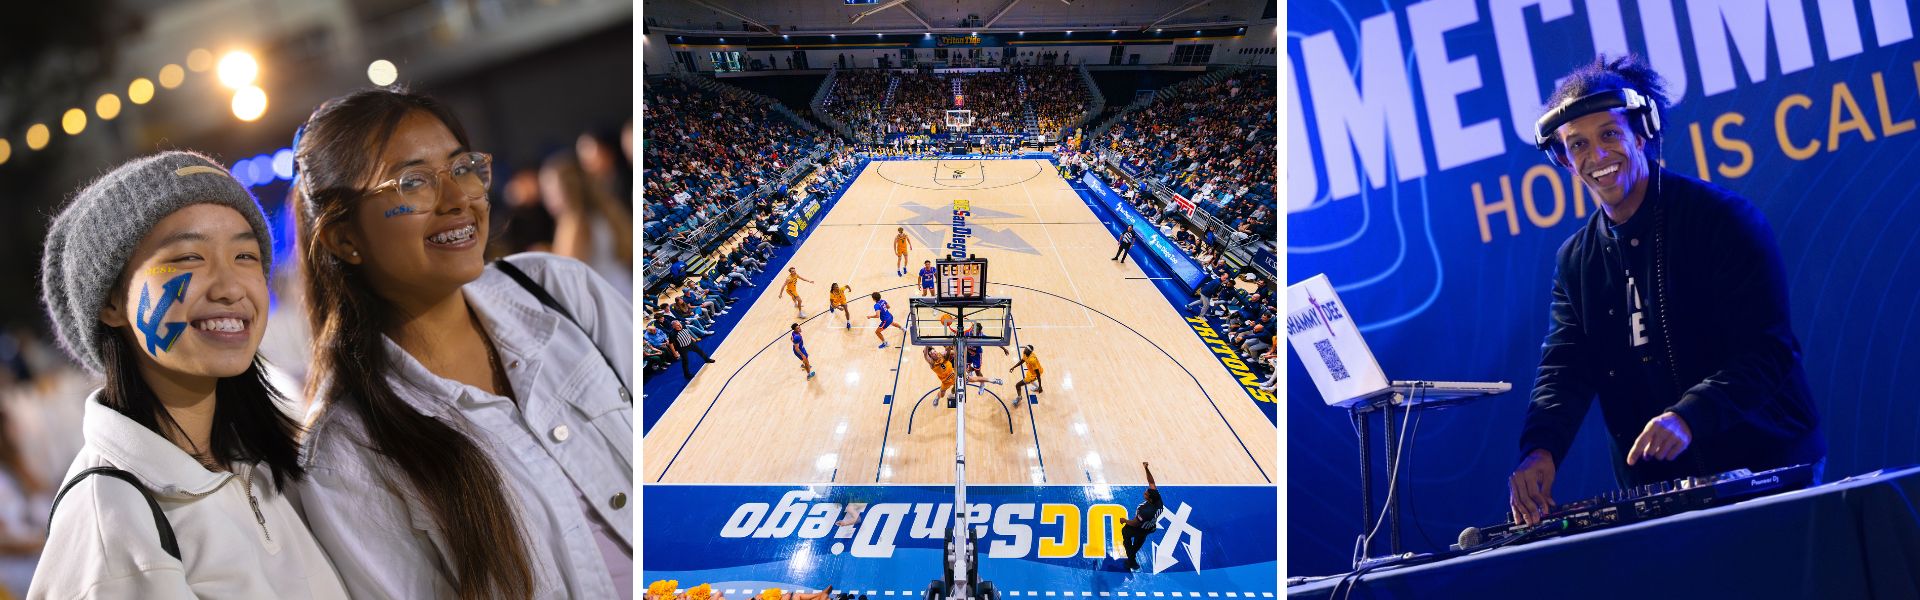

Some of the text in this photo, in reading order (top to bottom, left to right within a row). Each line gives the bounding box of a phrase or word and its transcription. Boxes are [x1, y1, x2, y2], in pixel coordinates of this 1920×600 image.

[1471, 160, 1603, 244] HO
[1689, 112, 1754, 183] IS
[1321, 301, 1343, 322] DEE
[1185, 316, 1277, 404] TRITONS
